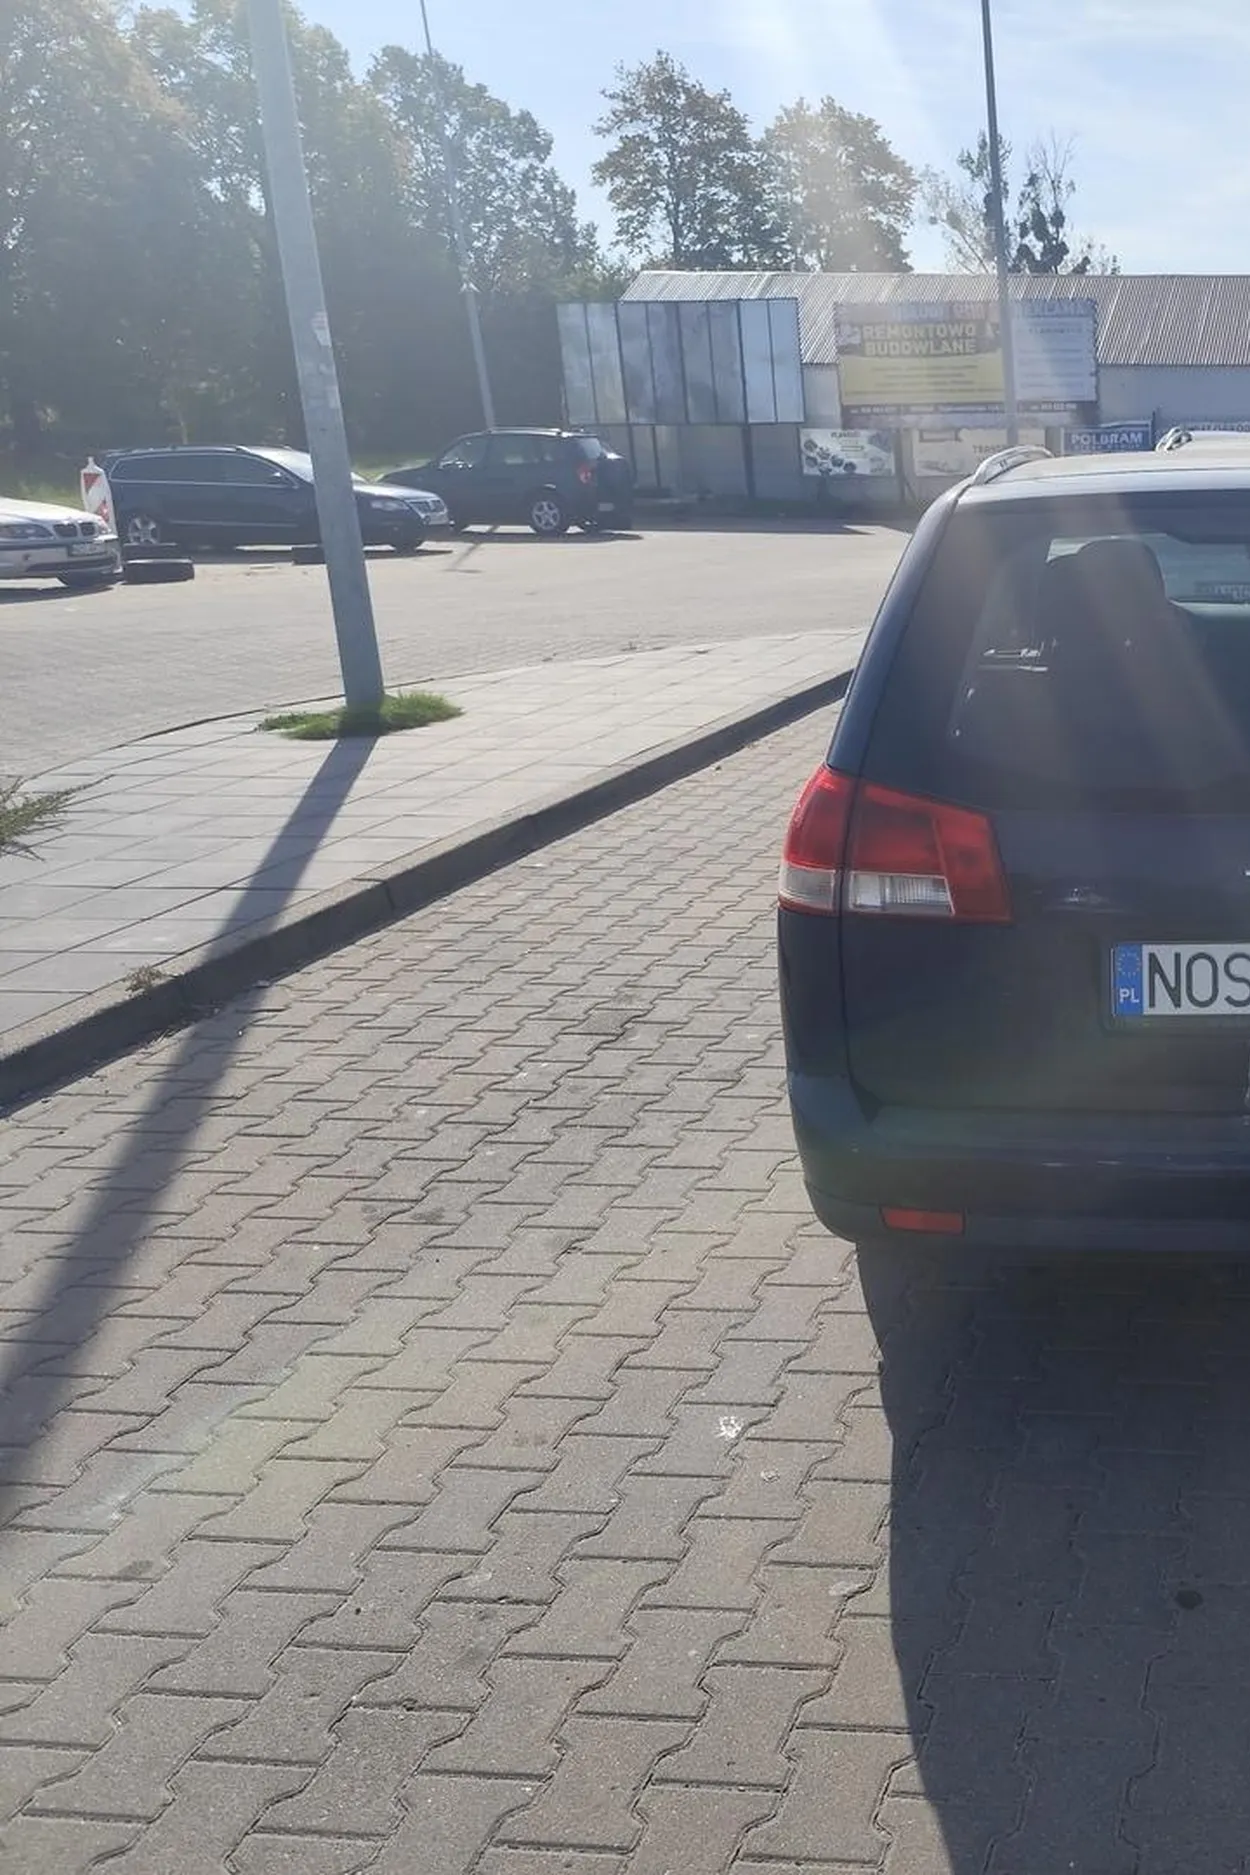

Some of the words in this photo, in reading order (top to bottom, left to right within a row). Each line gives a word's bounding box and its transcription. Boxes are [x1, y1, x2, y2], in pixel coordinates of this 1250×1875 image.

[862, 323, 976, 341] REMONTOWO
[865, 339, 976, 356] BUDOWLANE
[1119, 988, 1140, 1003] PL
